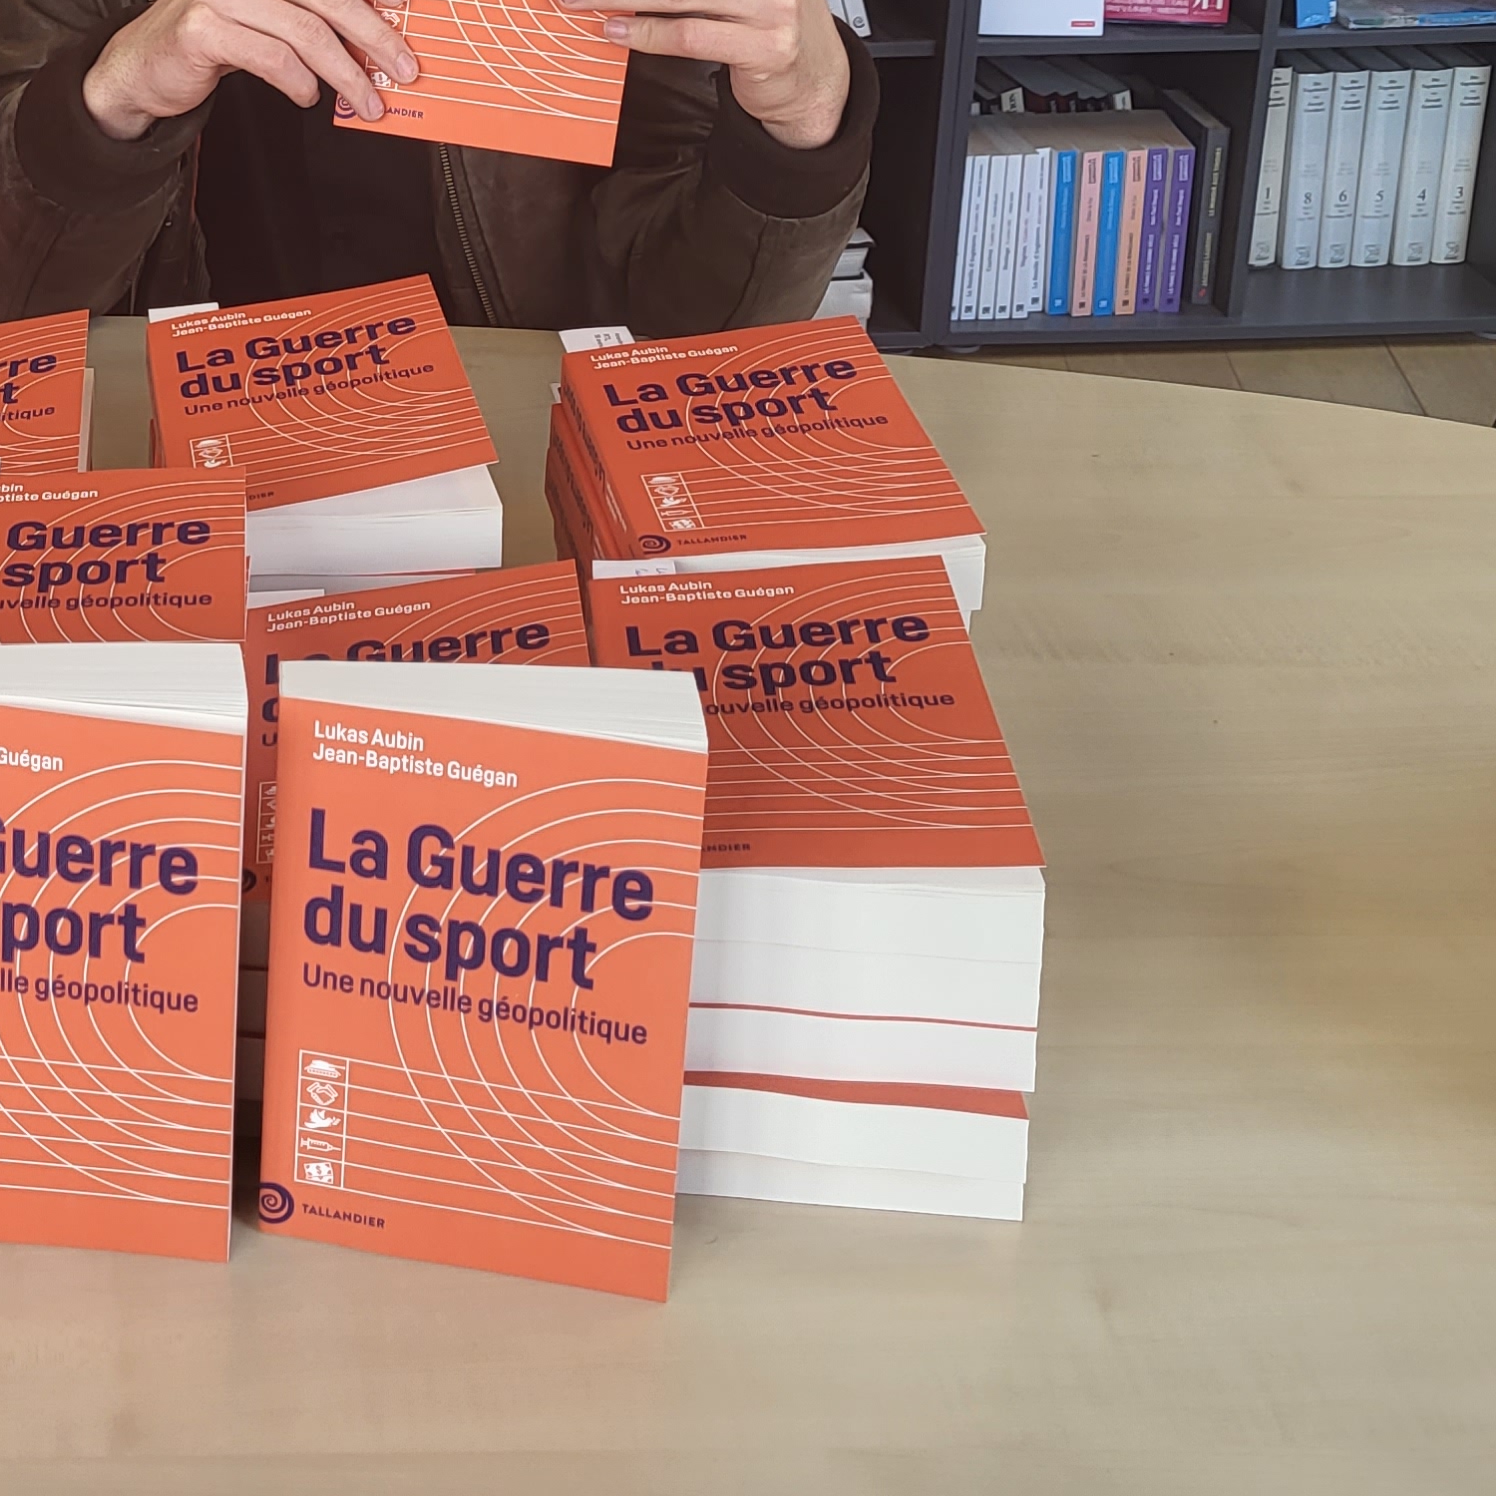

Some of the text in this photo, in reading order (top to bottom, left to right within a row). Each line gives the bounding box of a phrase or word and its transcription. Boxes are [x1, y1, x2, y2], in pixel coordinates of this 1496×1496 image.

[602, 353, 858, 409] La Guerre
[615, 384, 838, 437] du sport
[314, 720, 424, 752] Lukas Aubin
[313, 744, 518, 788] Jean-Baptiste Guégan
[308, 807, 654, 921] La Guerre
[303, 884, 597, 990] du sport
[34, 976, 199, 1014] géopolitique
[303, 963, 648, 1045] Une nouvelle géopolitique
[301, 1203, 386, 1229] TALLANDIER
